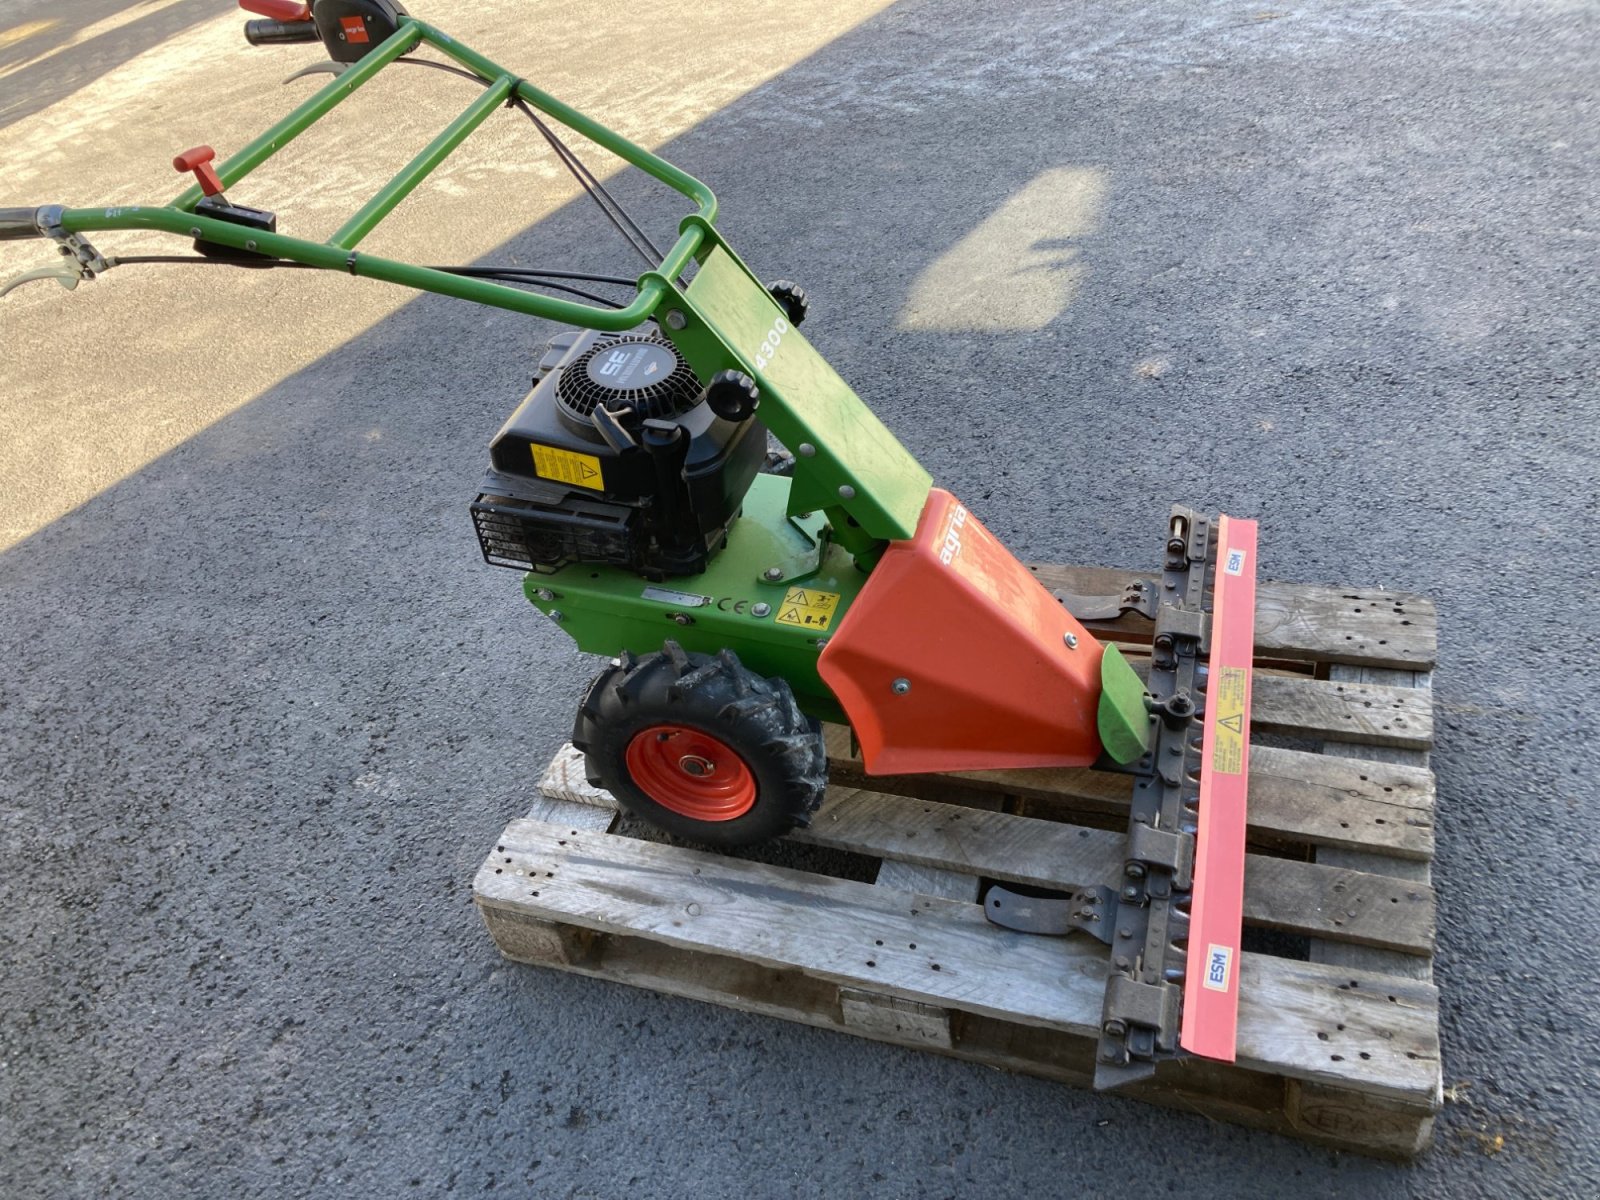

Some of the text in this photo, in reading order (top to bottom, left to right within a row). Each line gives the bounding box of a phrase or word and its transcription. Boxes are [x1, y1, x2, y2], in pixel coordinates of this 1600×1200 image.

[755, 317, 787, 370] 4300
[939, 504, 967, 566] agria
[1228, 554, 1241, 571] ESM
[717, 597, 748, 614] CE
[1209, 953, 1226, 984] ESM
